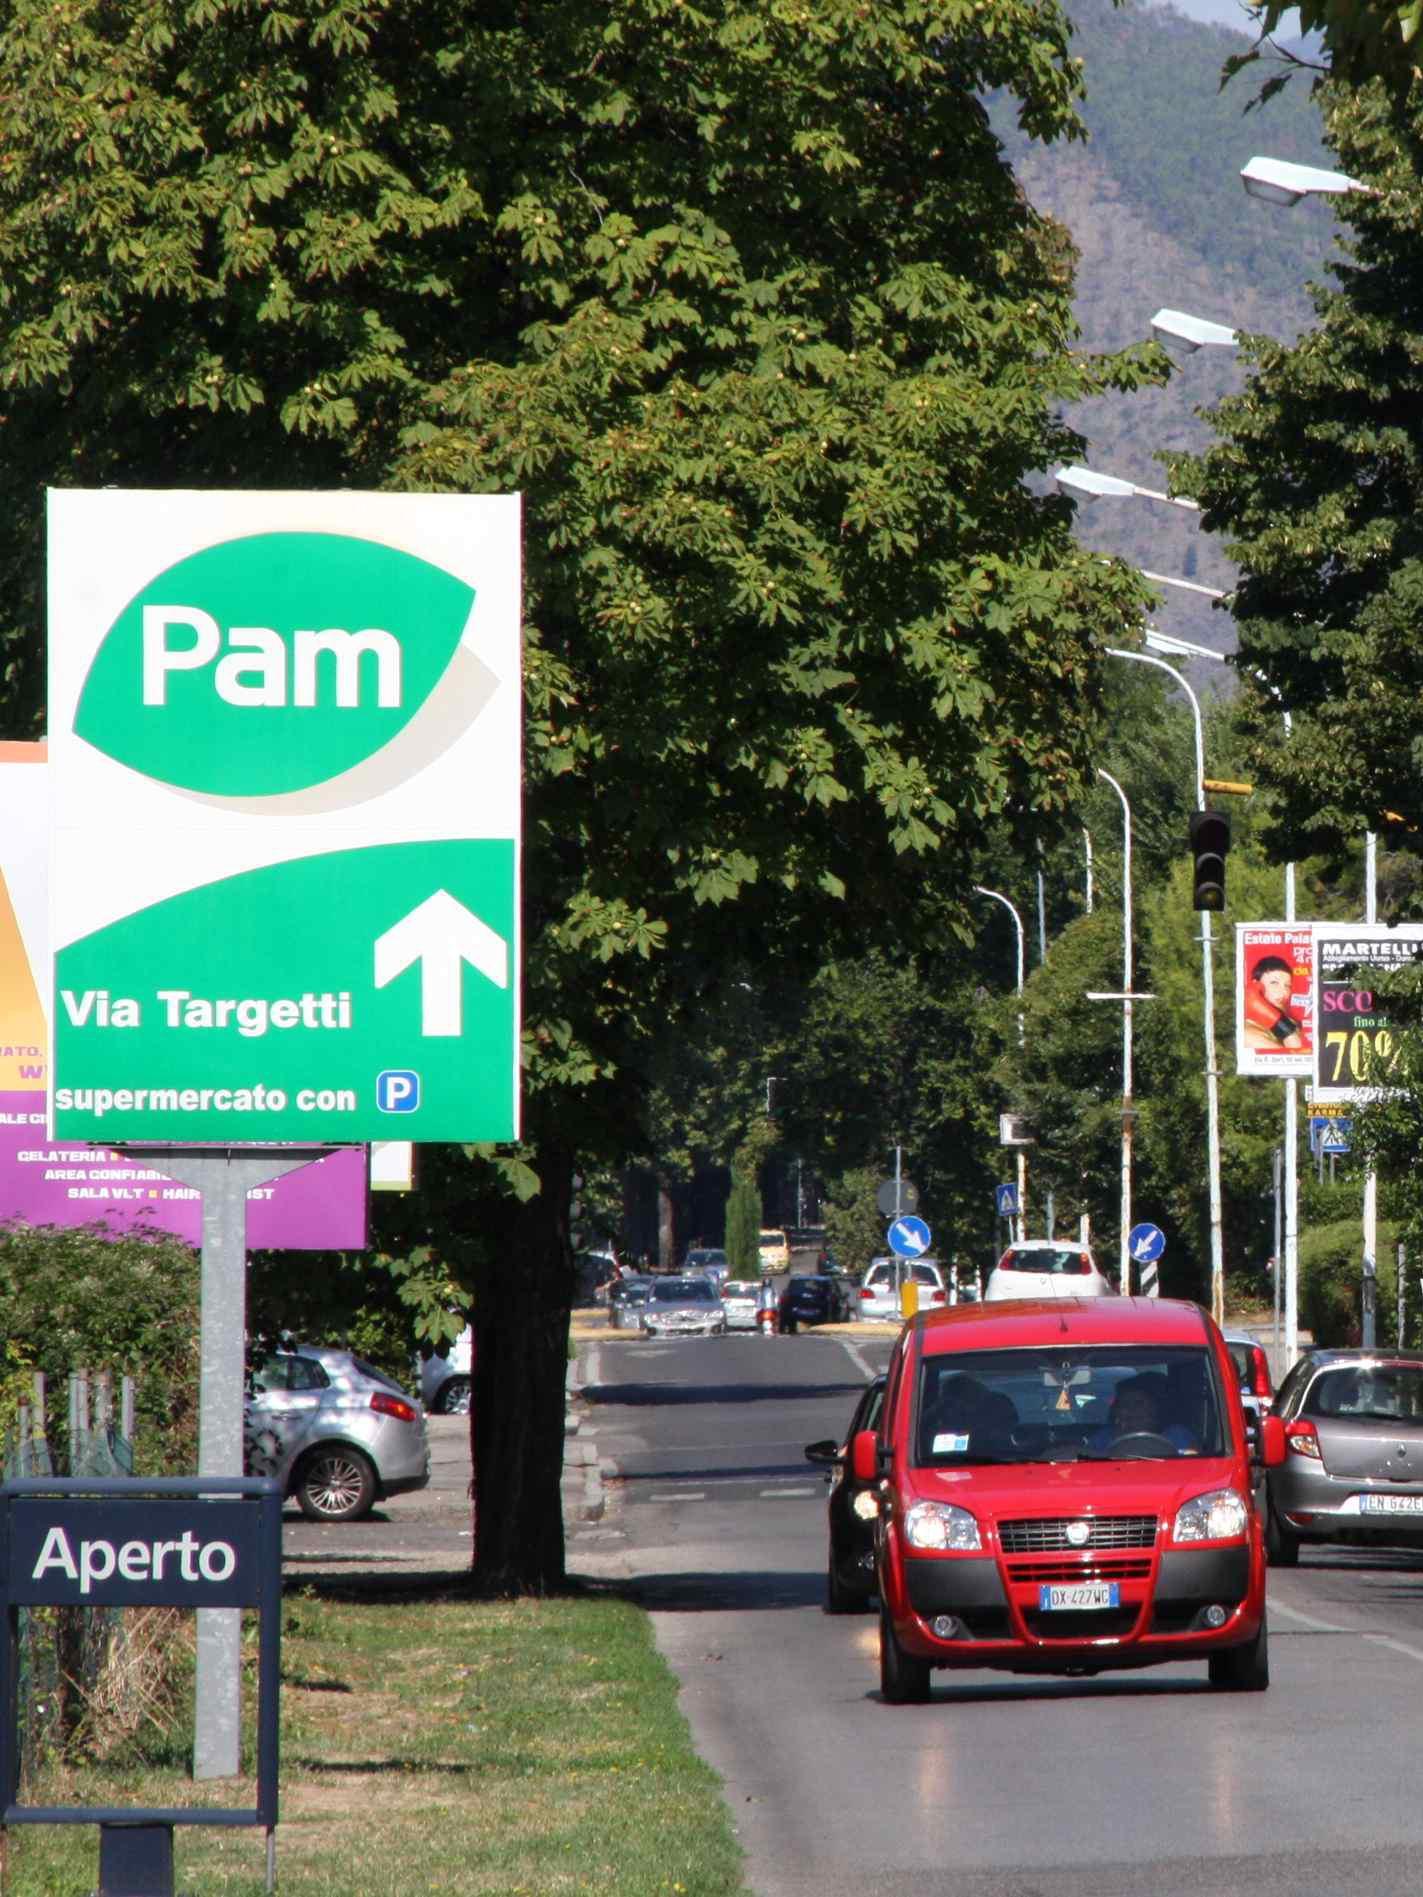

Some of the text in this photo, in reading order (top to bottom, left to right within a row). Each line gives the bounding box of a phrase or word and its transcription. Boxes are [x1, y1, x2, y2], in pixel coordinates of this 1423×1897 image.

[142, 604, 401, 708] Pam
[61, 990, 352, 1036] Via Targetti
[1353, 1016, 1375, 1027] fino
[55, 1083, 287, 1117] supermercato
[295, 1089, 356, 1112] con
[17, 1151, 106, 1162] GELATERIA
[44, 1169, 86, 1180] AREA
[68, 1188, 110, 1199] SALA
[111, 1188, 145, 1199] VLT
[31, 1527, 237, 1594] Aperto
